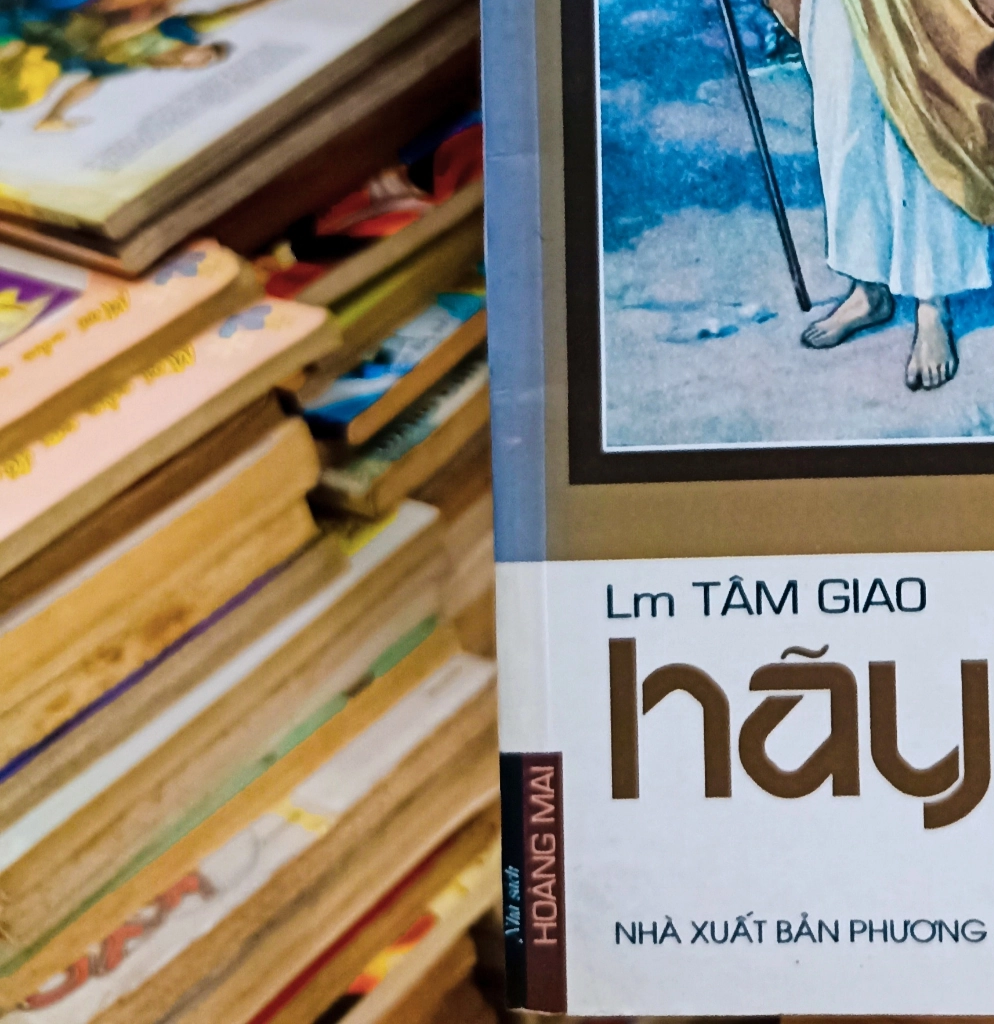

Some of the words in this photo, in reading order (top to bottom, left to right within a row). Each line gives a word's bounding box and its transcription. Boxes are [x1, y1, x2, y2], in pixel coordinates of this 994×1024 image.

[606, 583, 675, 619] Lm
[691, 574, 799, 617] TÂM
[817, 576, 927, 615] GIAO
[607, 636, 992, 830] hãy
[529, 765, 556, 824] MAI
[614, 914, 682, 946] NHÀ
[690, 911, 768, 945] XUẤT
[775, 911, 840, 944] BẢN
[848, 917, 988, 944] PHƯƠNG
